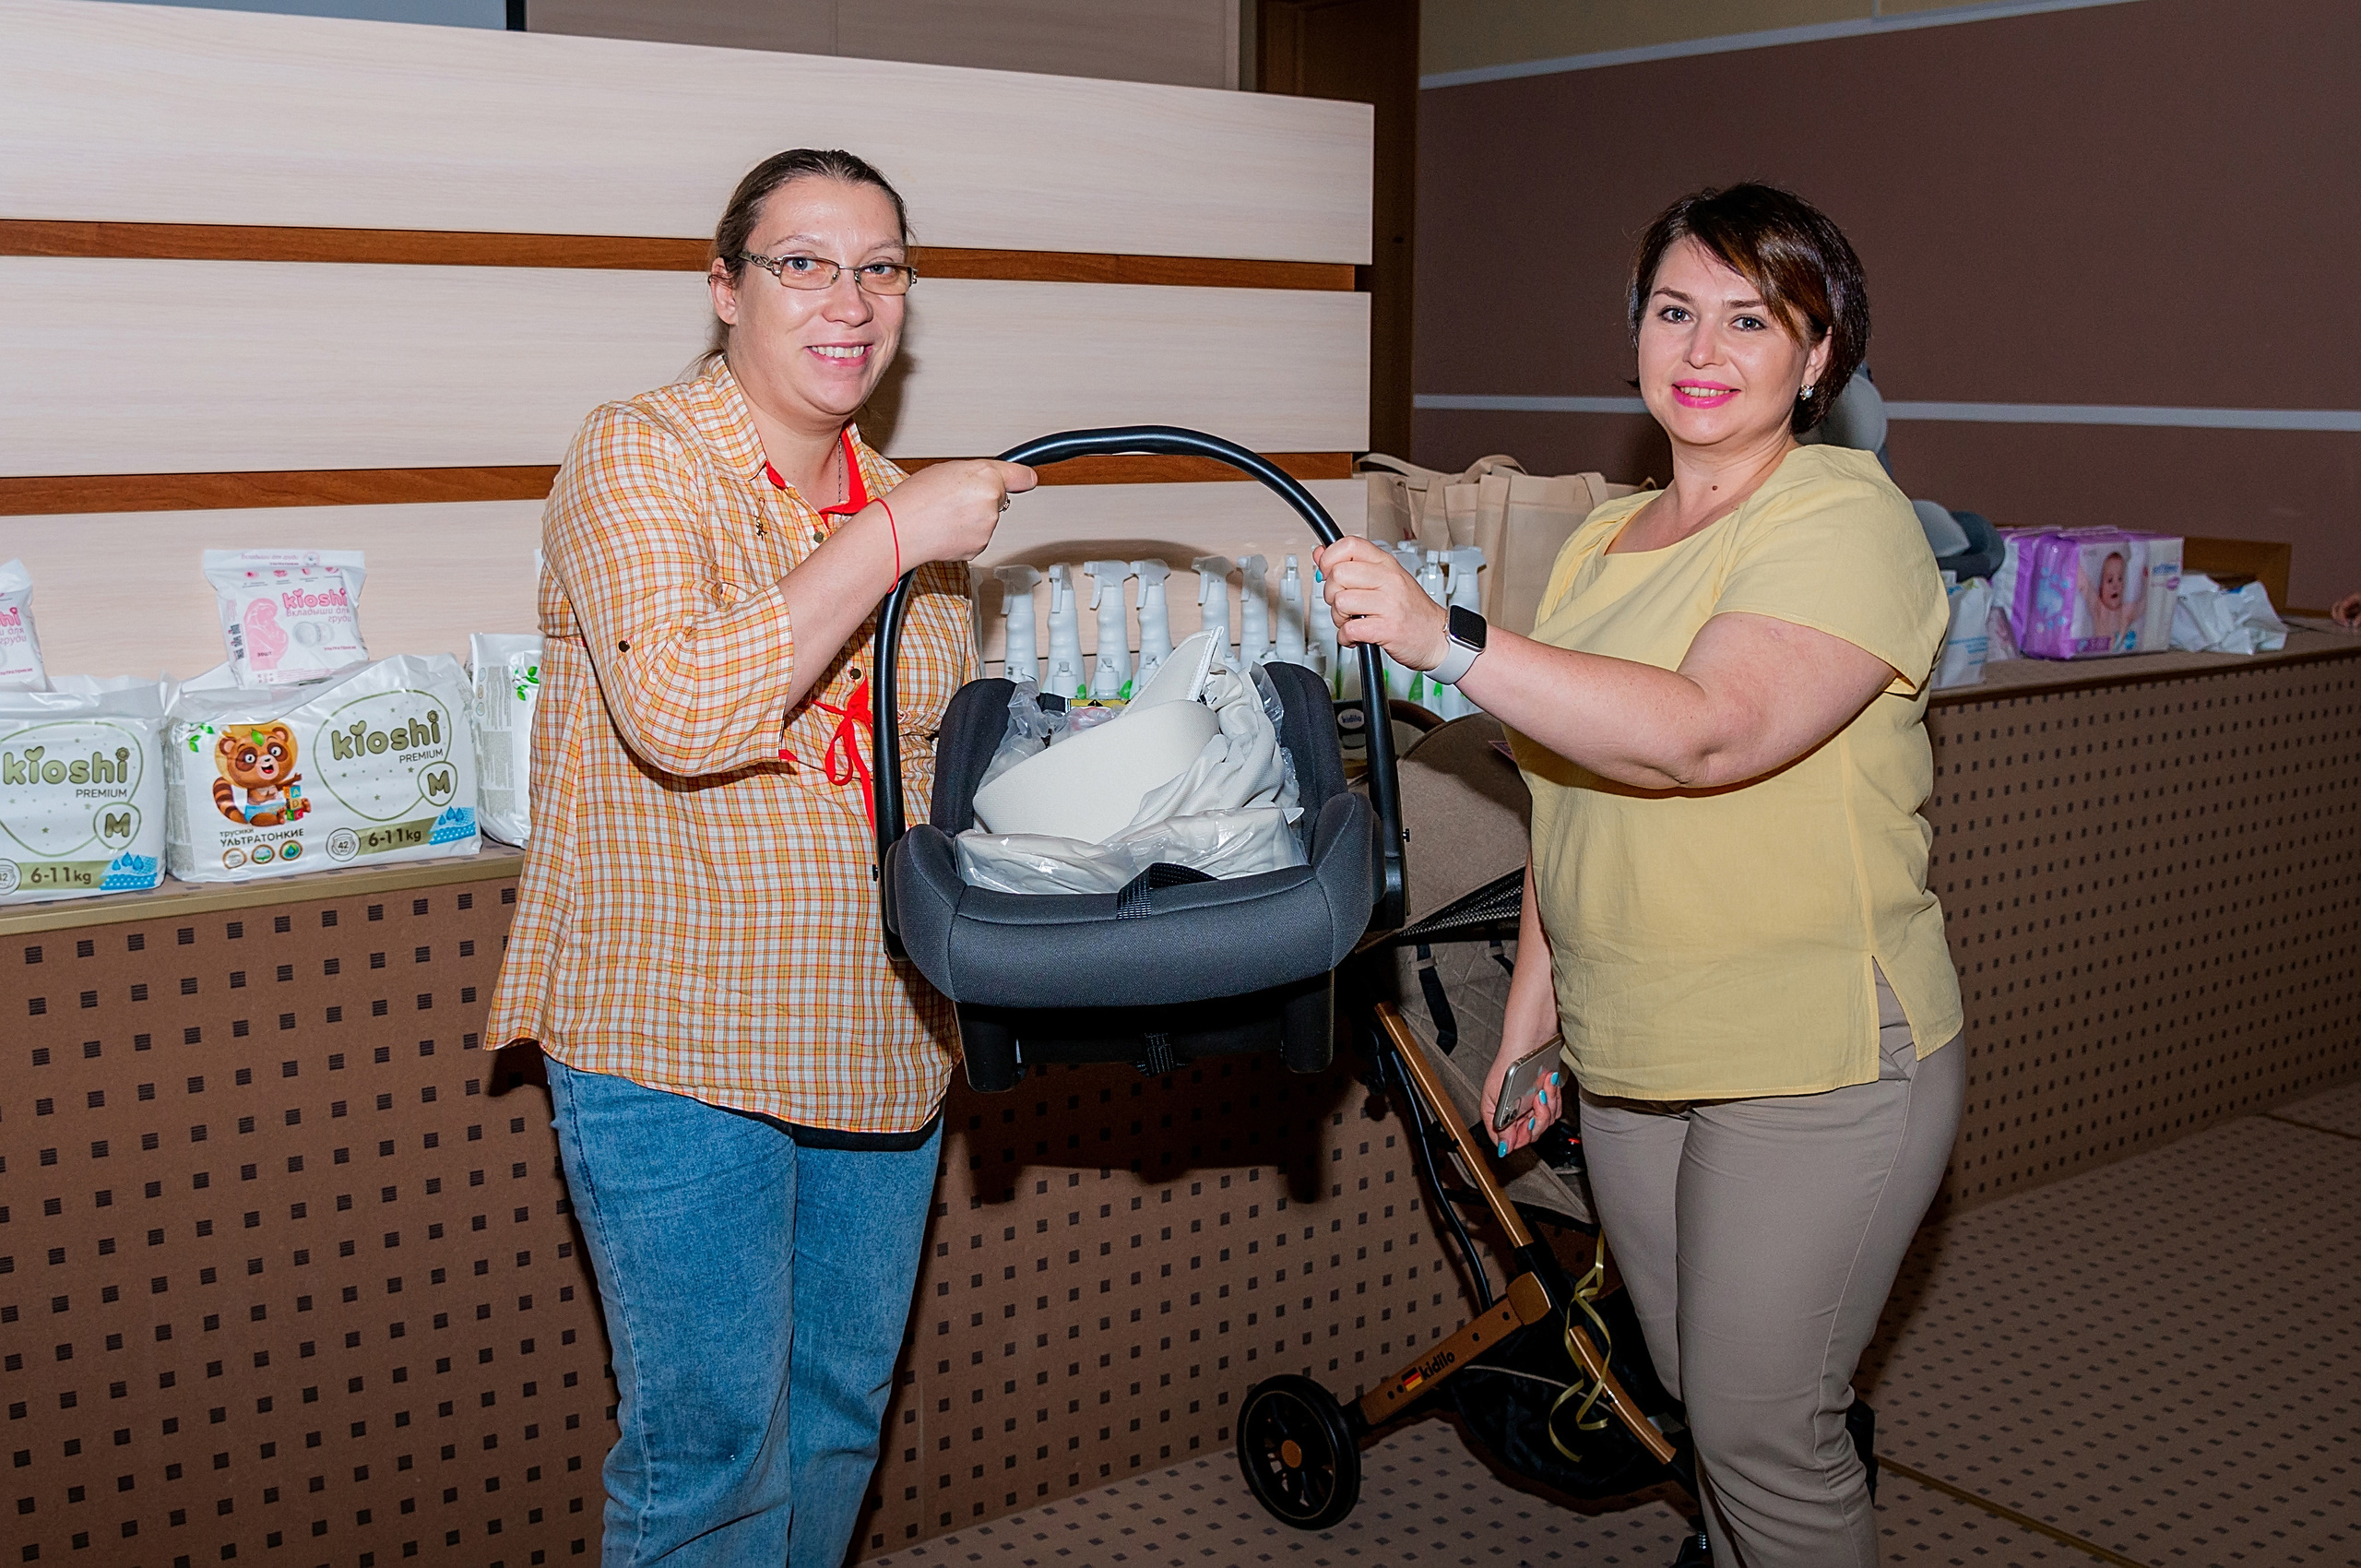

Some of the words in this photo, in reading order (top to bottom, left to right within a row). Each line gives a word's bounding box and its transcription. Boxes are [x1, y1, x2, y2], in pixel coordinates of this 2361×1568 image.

[282, 588, 349, 609] kioshi
[286, 607, 333, 617] Вкладыши
[336, 606, 350, 614] для
[327, 615, 352, 624] груди
[331, 710, 441, 760] kioshi
[4, 746, 130, 784] kioshi
[399, 749, 443, 763] PREMIUM
[76, 789, 127, 798] PREMIUM
[427, 770, 451, 796] M
[104, 813, 131, 838] M
[220, 828, 304, 847] УЛЬТРАТОНКИЕ
[1418, 1351, 1455, 1380] kidilo
